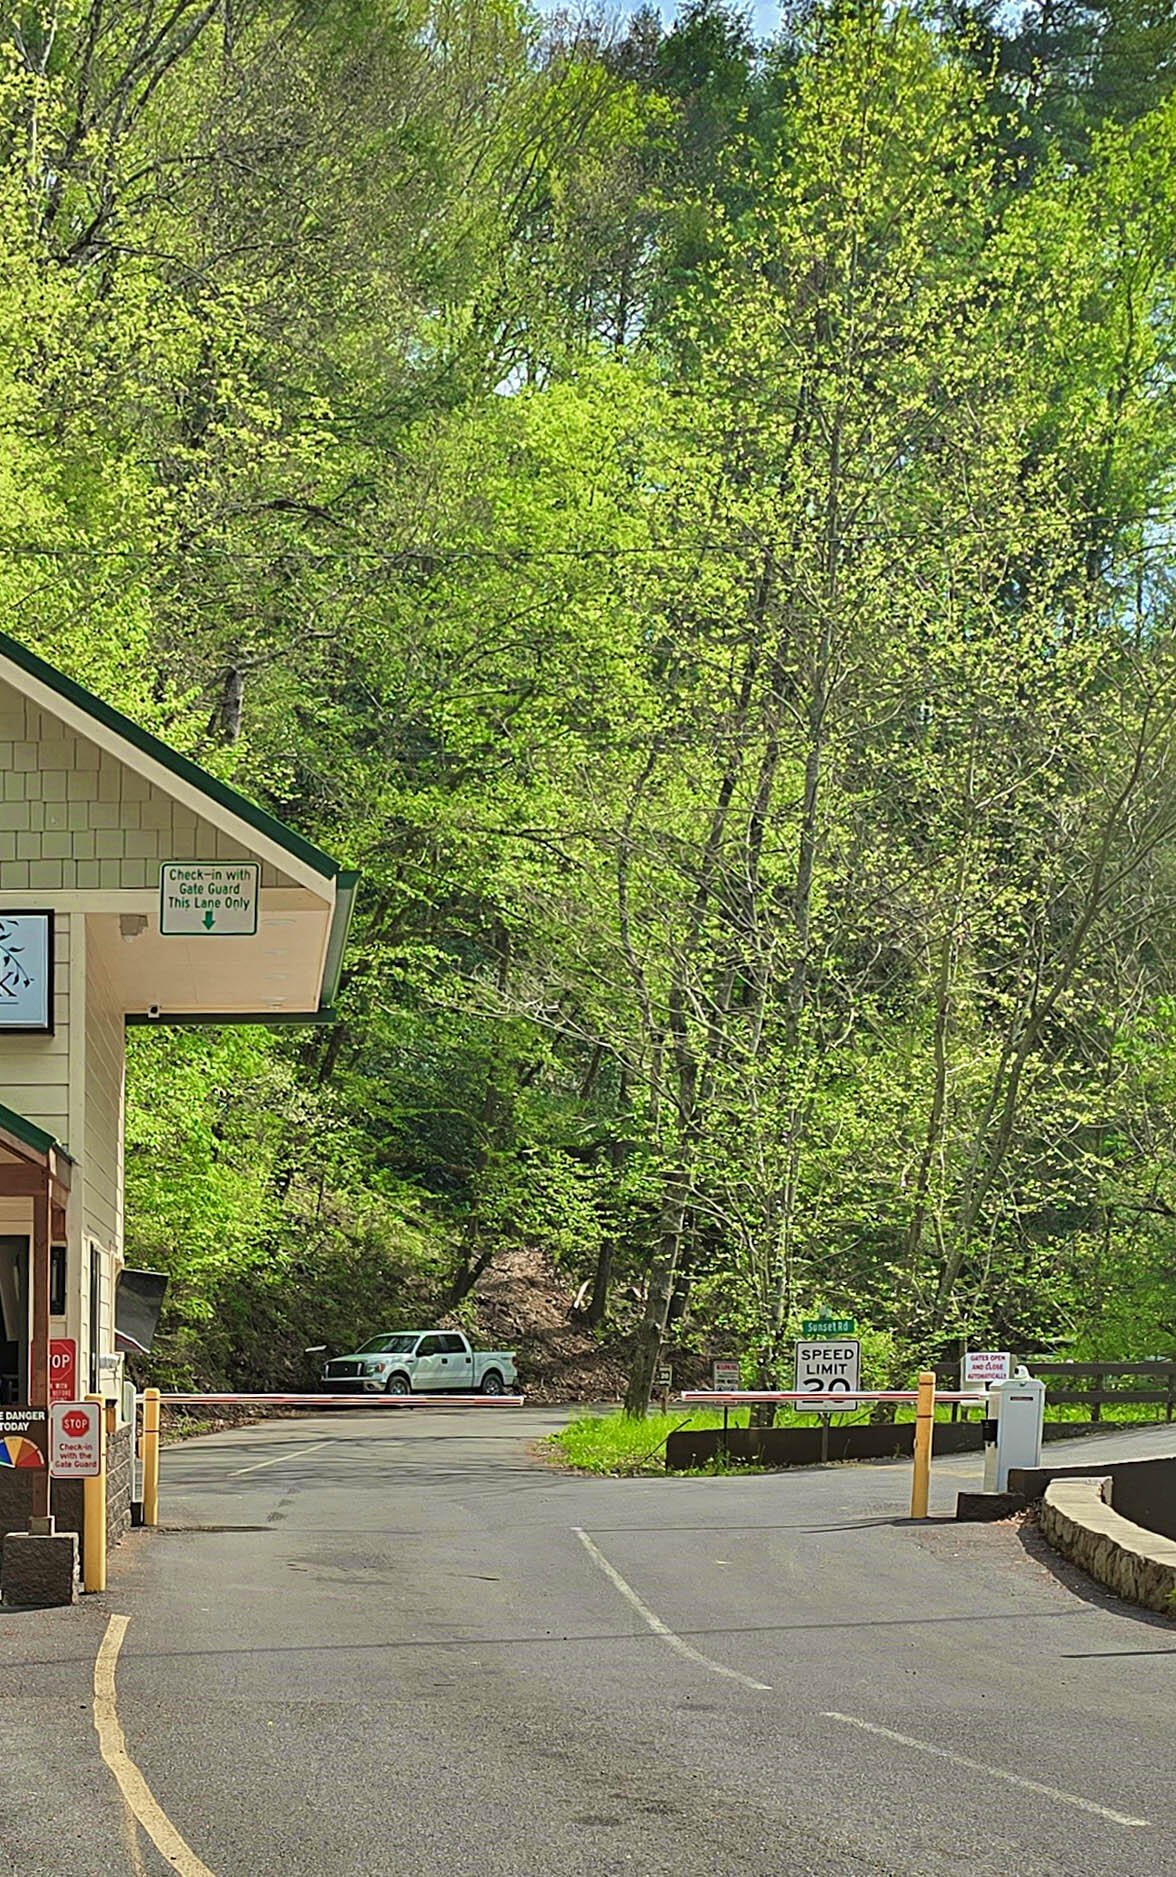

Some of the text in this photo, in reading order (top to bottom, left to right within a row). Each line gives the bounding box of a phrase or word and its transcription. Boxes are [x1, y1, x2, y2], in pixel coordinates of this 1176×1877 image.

[169, 869, 251, 881] Check-in with
[179, 883, 240, 895] Gate Guard
[168, 897, 250, 911] This Lane Only
[807, 1321, 849, 1333] Sunset Rd
[801, 1349, 855, 1360] SPEED
[806, 1363, 848, 1375] LIMIT
[802, 1378, 851, 1403] 20
[5, 1411, 45, 1420] DANGER
[64, 1418, 88, 1430] STOP
[59, 1443, 93, 1451] Check-in
[60, 1452, 92, 1460] with the
